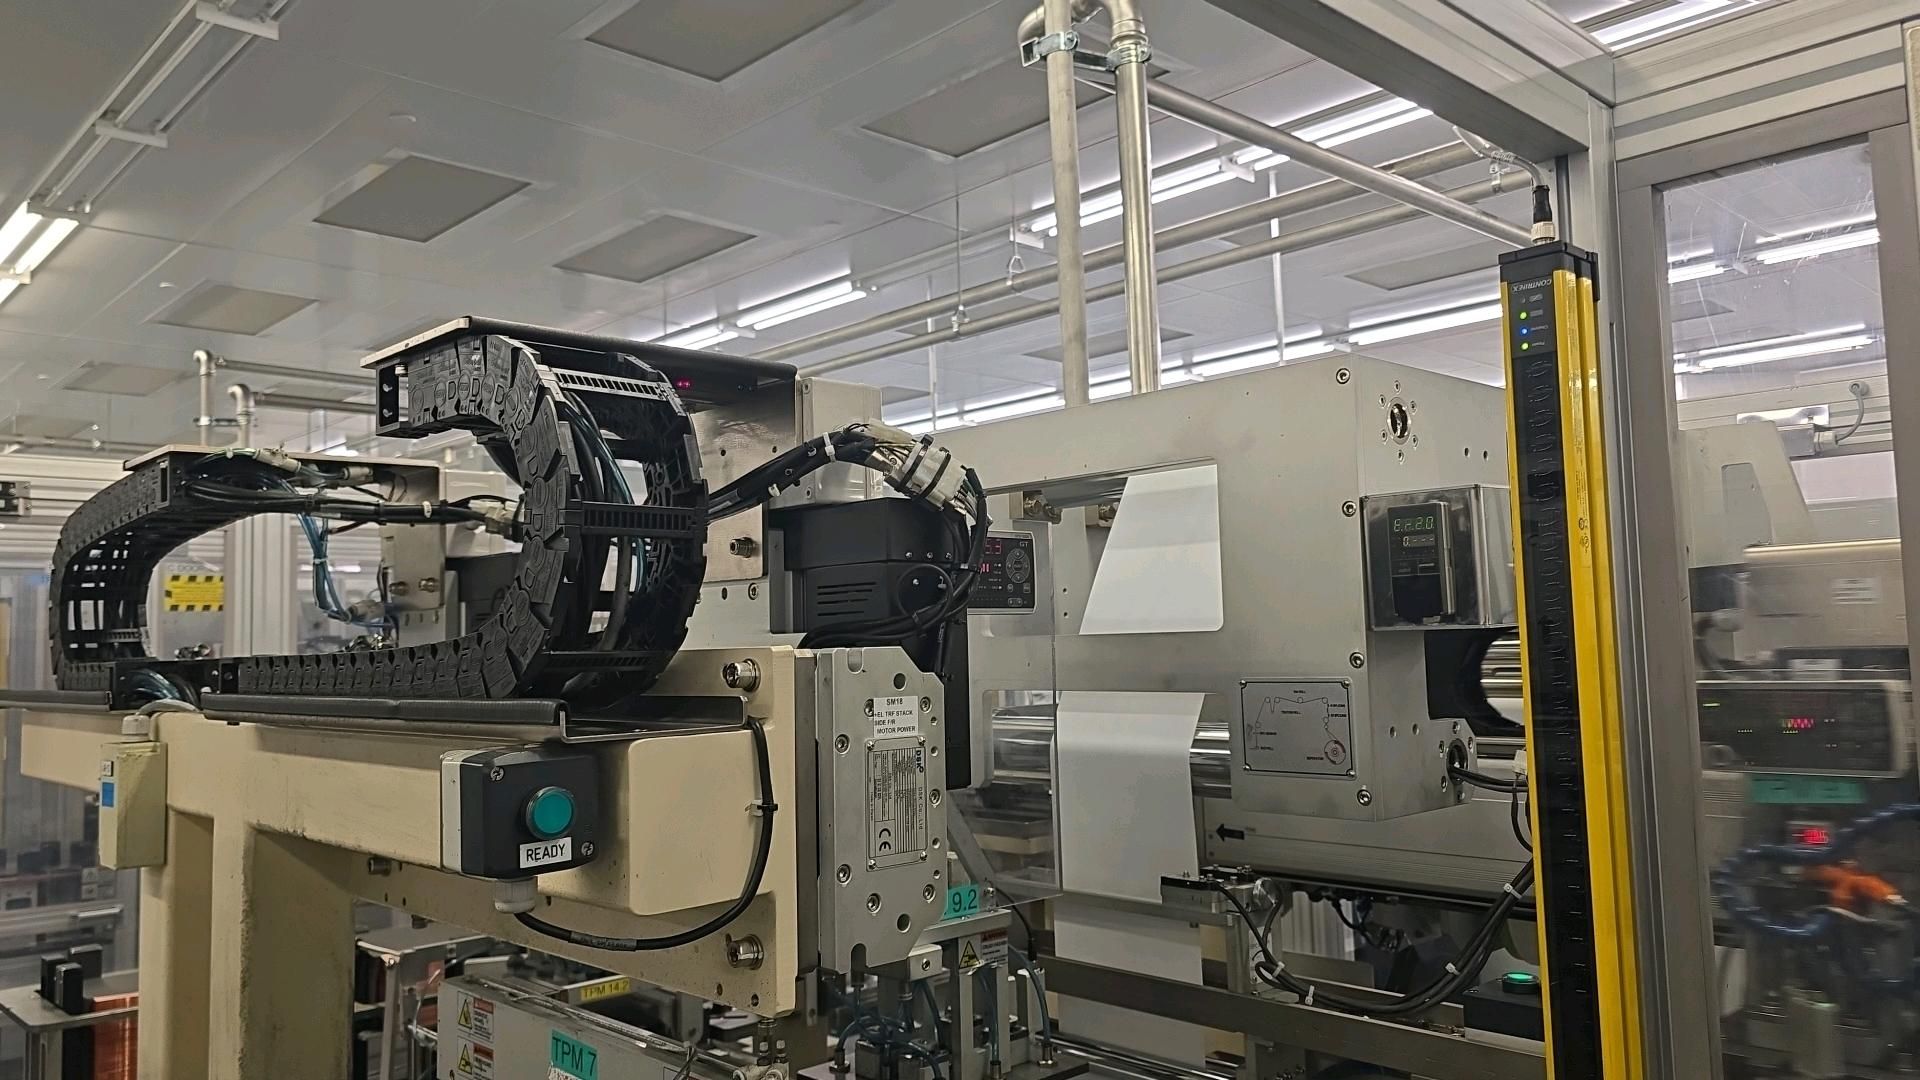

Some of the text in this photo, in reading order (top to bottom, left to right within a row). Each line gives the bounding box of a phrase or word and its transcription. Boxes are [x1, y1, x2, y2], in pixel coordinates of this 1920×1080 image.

[886, 697, 904, 706] SM18
[526, 843, 566, 862] READY
[952, 888, 978, 913] 9.2
[552, 1036, 597, 1077] TPM 7
